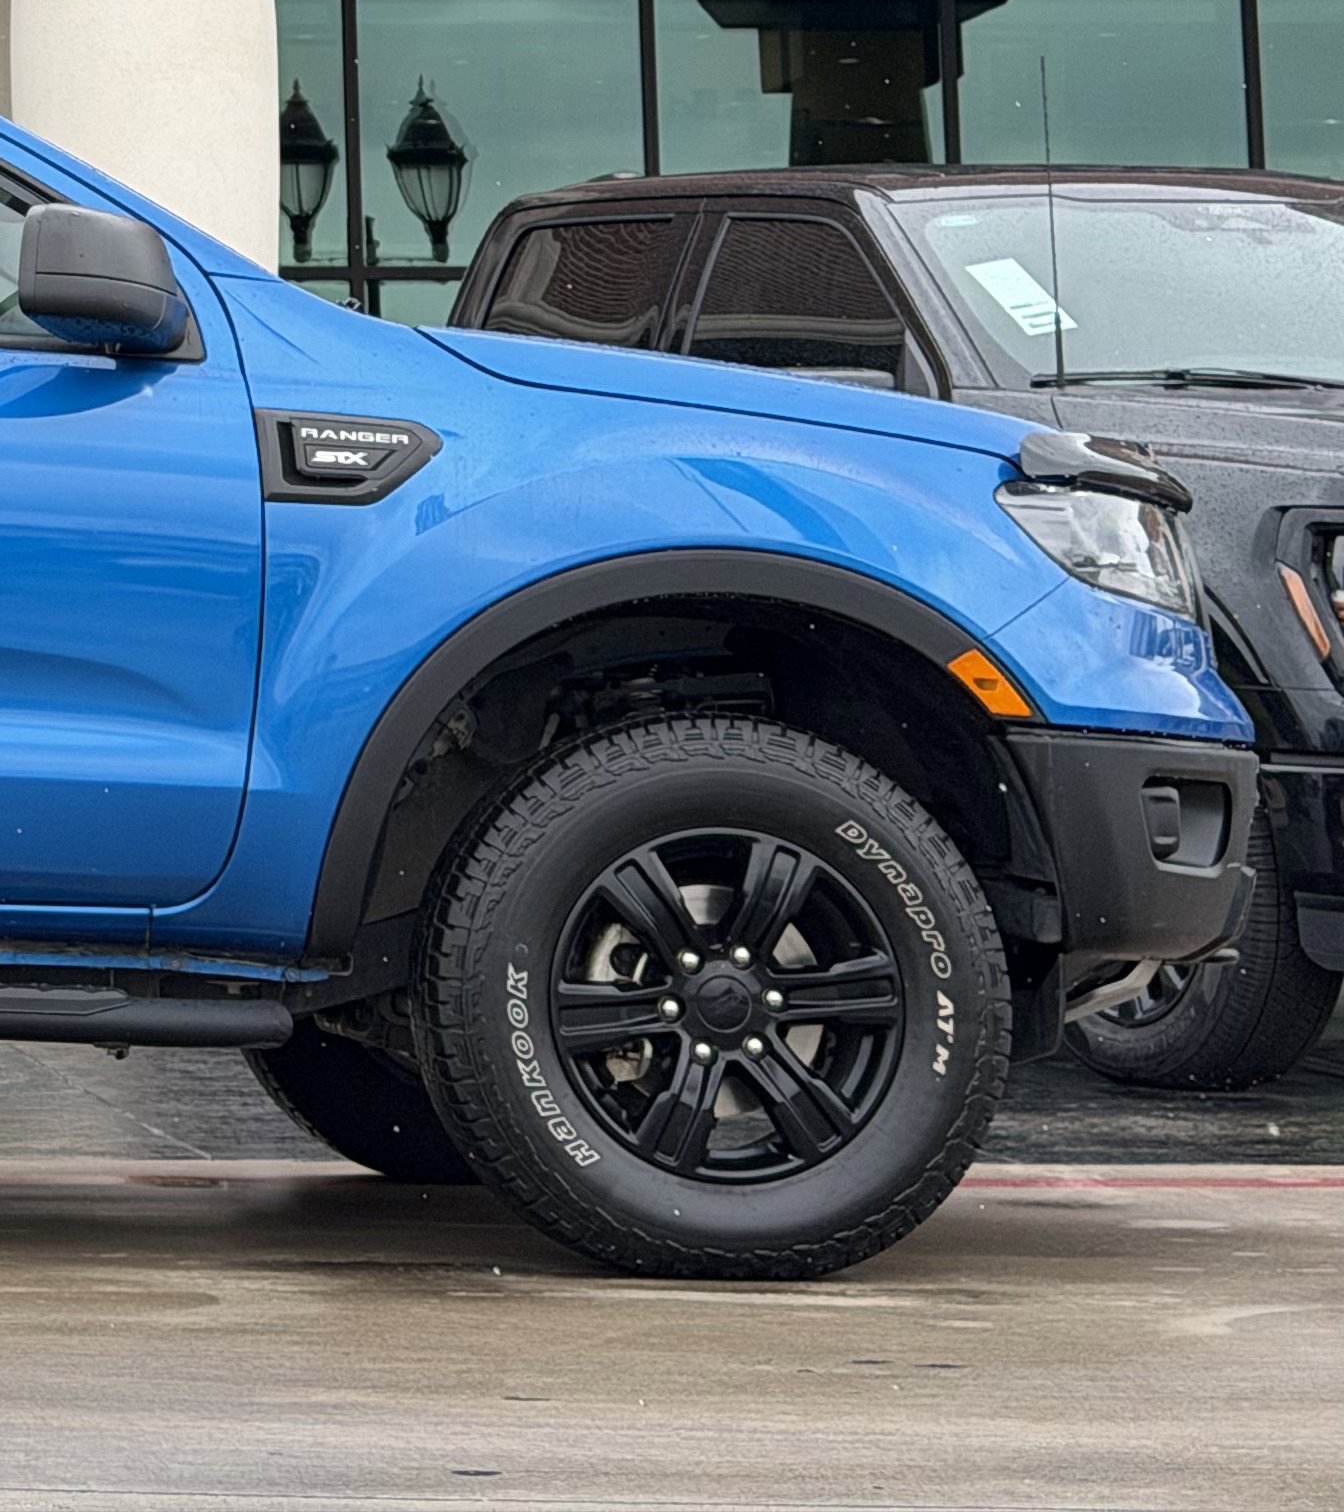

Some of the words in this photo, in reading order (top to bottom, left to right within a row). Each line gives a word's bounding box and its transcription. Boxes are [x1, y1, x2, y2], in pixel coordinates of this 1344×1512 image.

[301, 427, 409, 445] RANGER
[312, 450, 368, 466] STX
[834, 820, 953, 979] Dynapro
